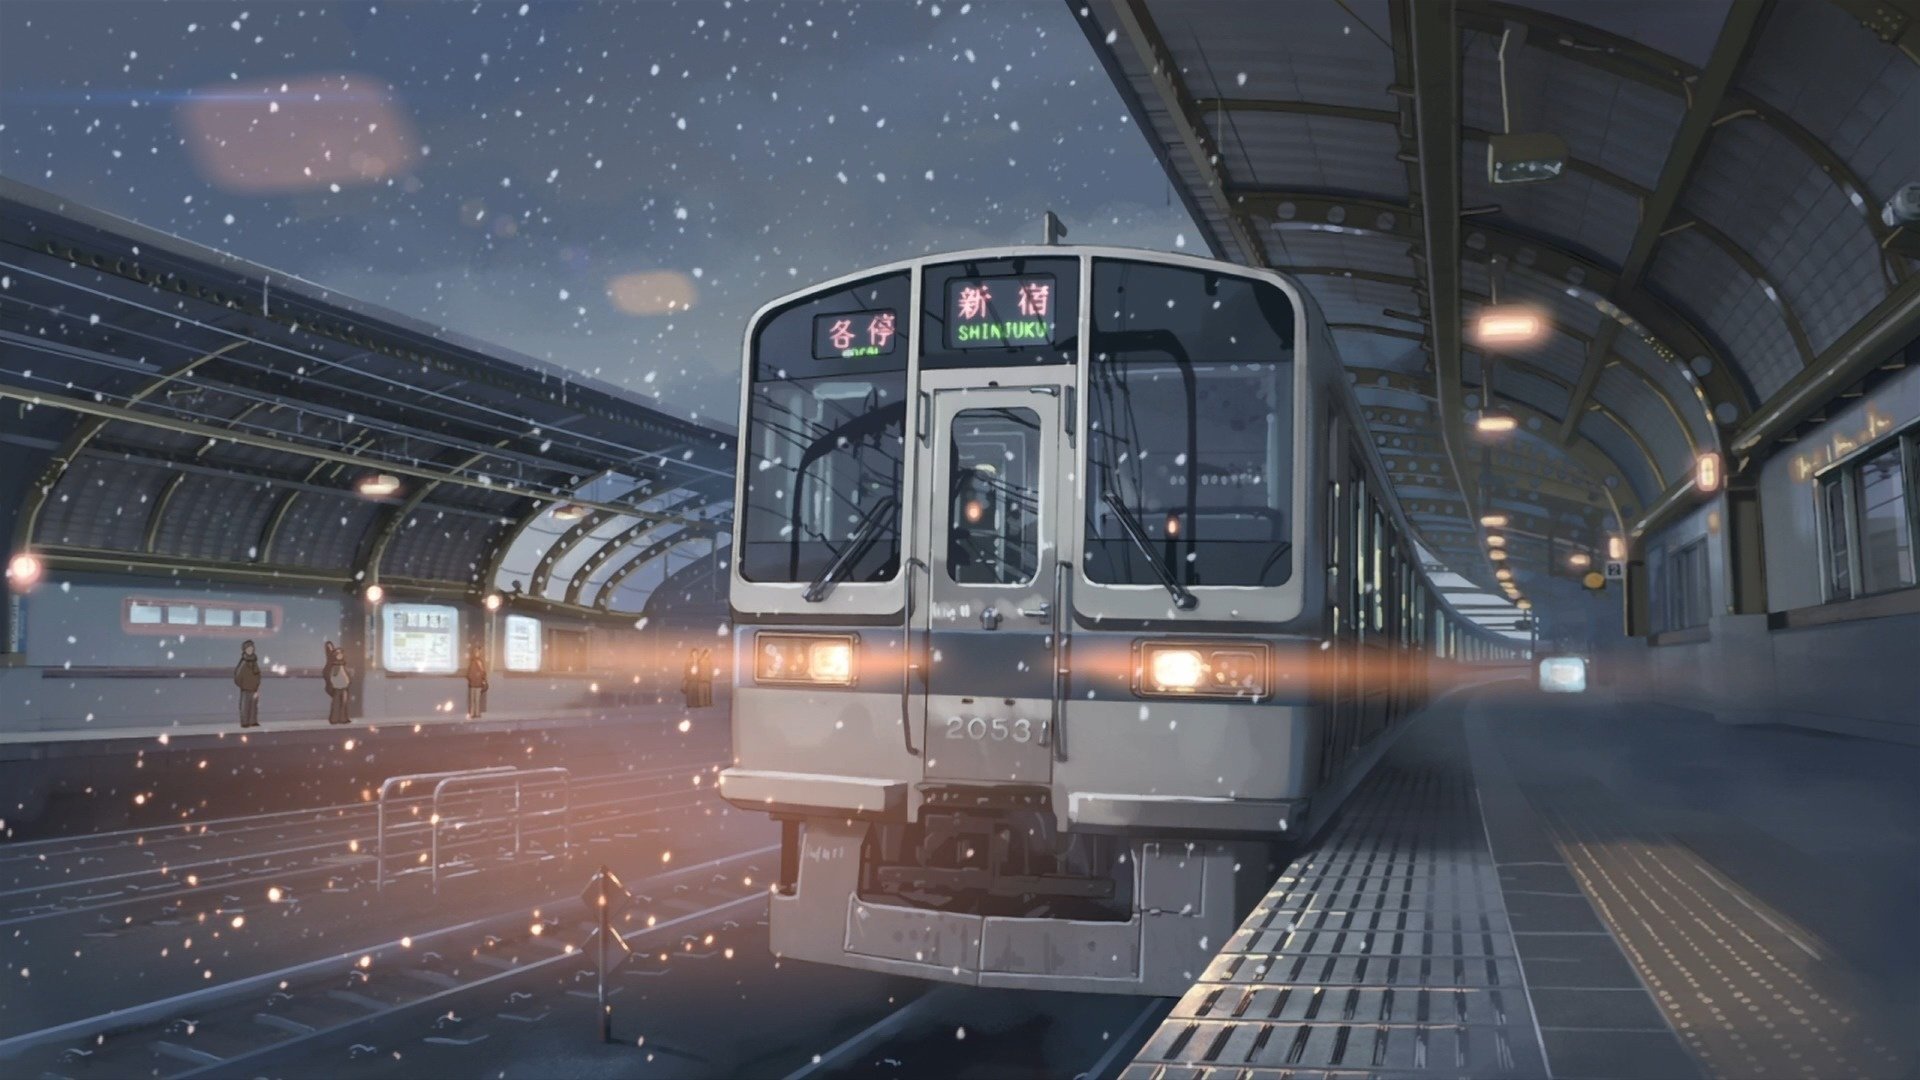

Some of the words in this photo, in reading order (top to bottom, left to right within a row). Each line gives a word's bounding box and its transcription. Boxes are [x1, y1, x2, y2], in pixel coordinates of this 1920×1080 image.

[959, 283, 1049, 319] 新宿
[829, 313, 895, 349] 各停
[958, 321, 1047, 341] SHINJUKU
[946, 716, 1031, 743] 2053
